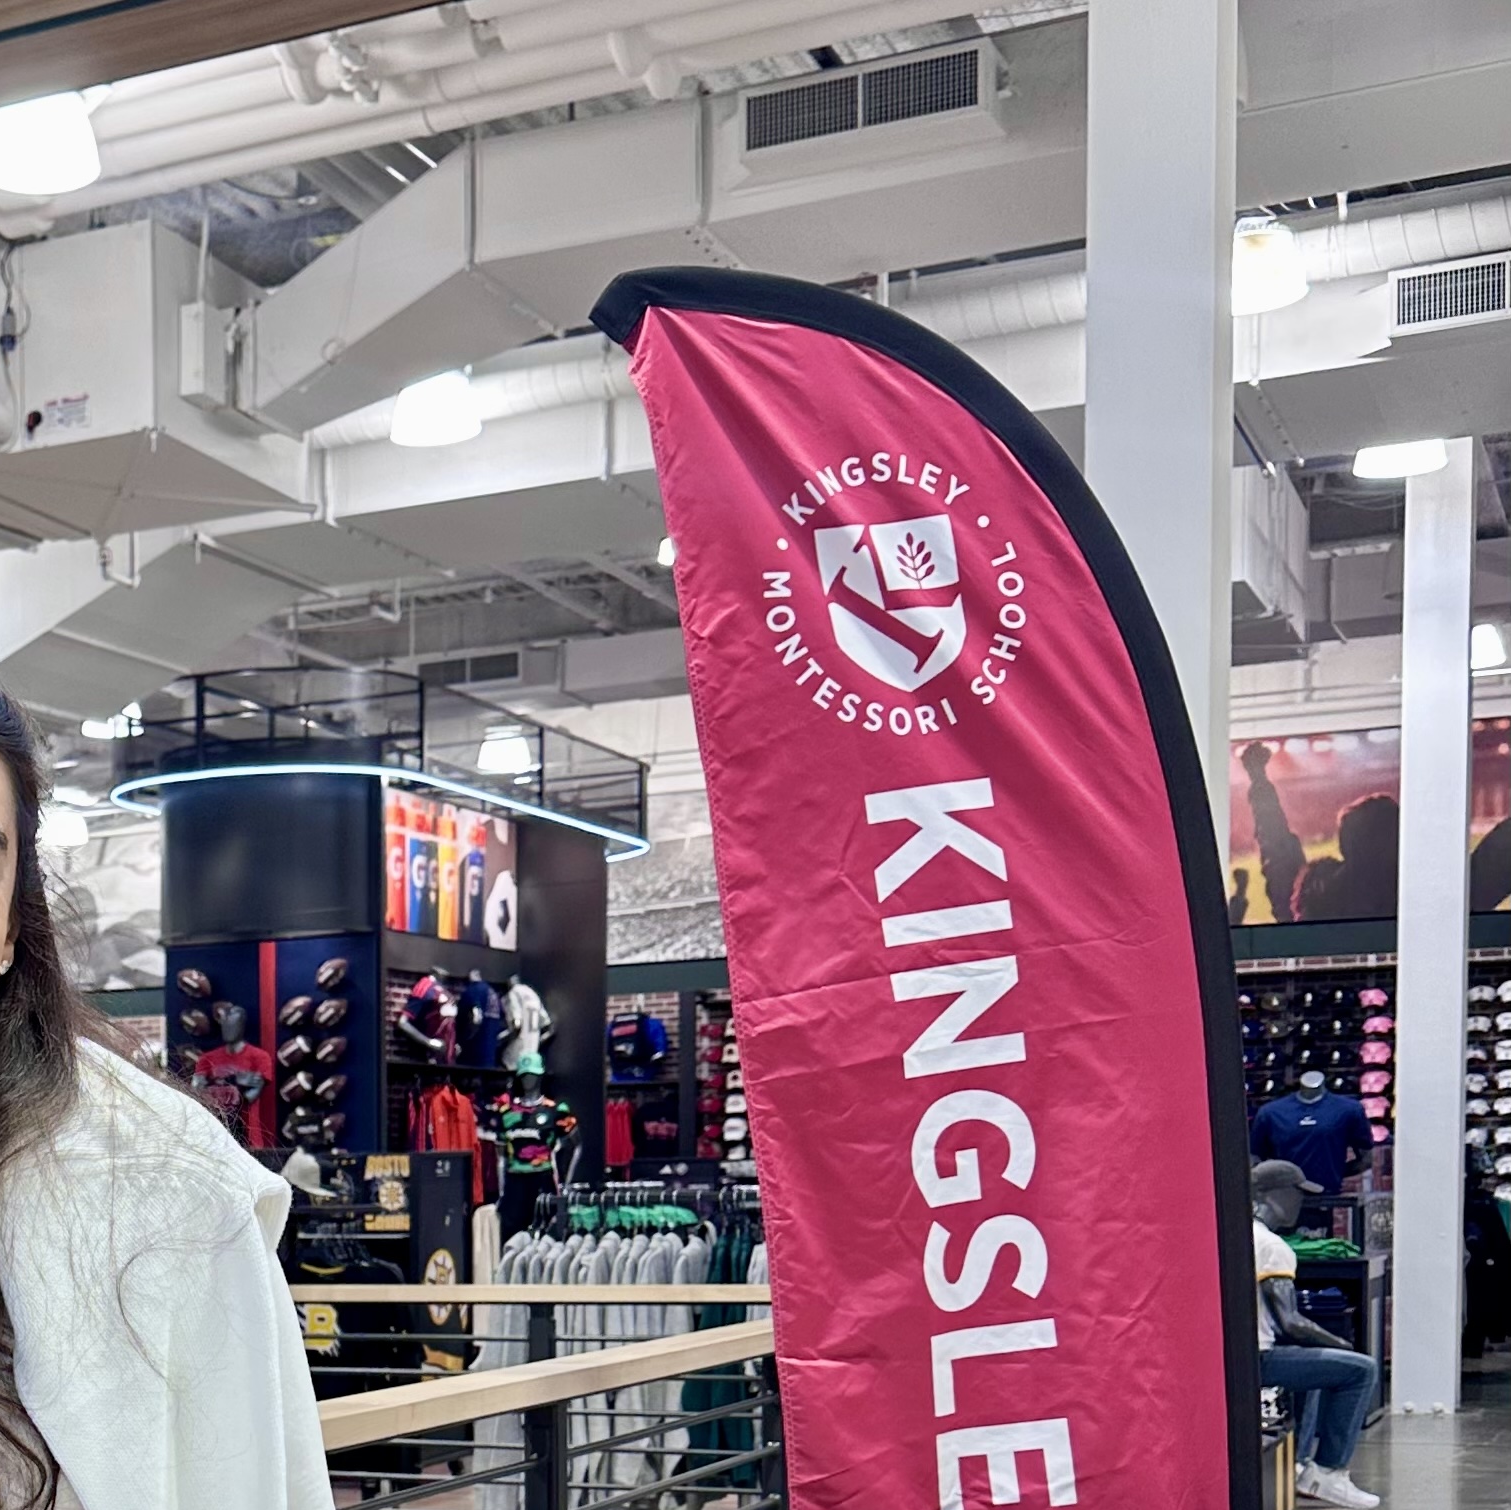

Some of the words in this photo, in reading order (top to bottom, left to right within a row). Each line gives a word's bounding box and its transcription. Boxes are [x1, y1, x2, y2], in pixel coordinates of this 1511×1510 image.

[782, 452, 970, 526] KINGSLEY
[762, 571, 957, 736] MONTESSORI
[970, 542, 1027, 705] SCHOOL
